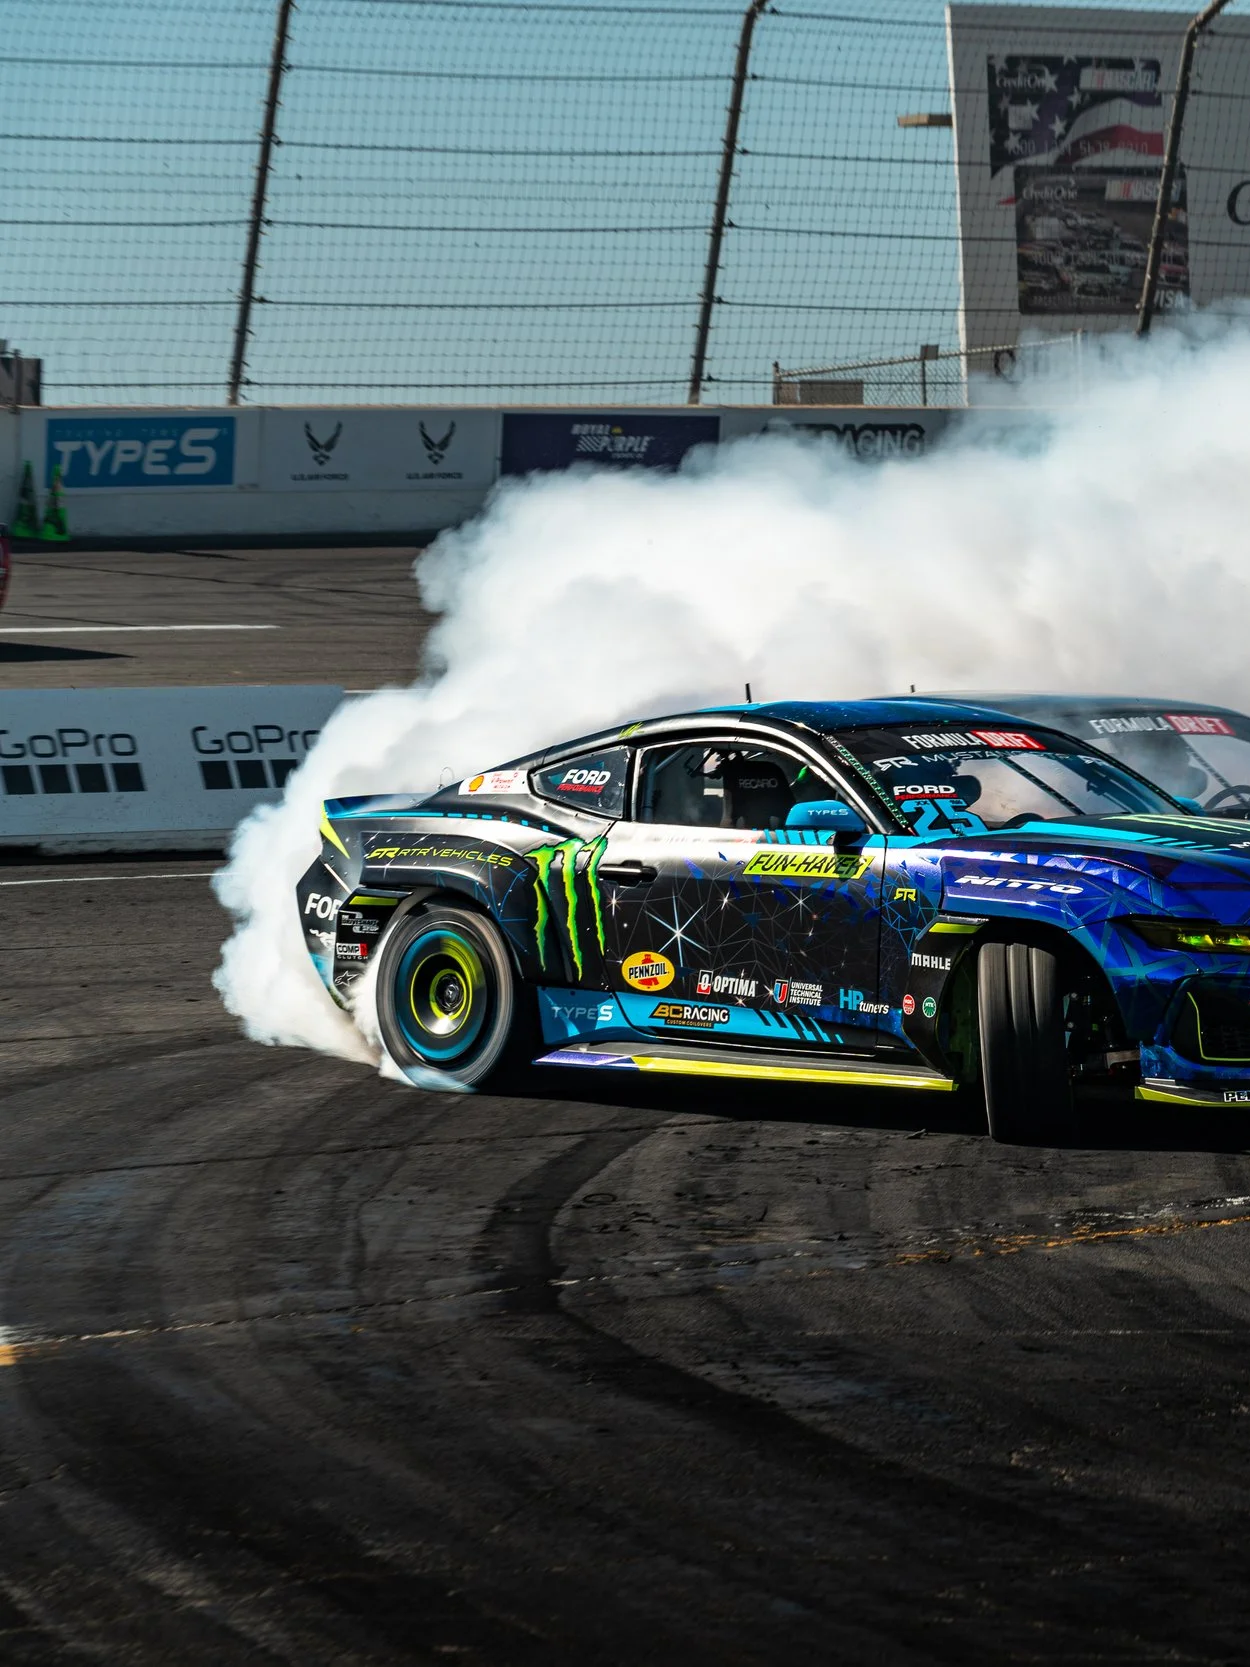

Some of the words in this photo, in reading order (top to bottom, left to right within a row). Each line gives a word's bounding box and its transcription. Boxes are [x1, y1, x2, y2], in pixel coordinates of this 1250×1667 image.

[1088, 716, 1174, 734] FORMULA
[1167, 715, 1230, 734] DRIFT
[0, 728, 137, 759] GoPro
[902, 732, 988, 750] FORMULA
[976, 731, 1041, 749] DRIFT
[561, 769, 611, 785] FORD
[739, 778, 779, 789] RECARO
[893, 785, 956, 796] FORD
[900, 799, 989, 838] 25
[432, 848, 513, 867] VEHICLES
[748, 853, 868, 876] FUN-HAVER
[954, 875, 1084, 894] NITTO
[911, 952, 951, 971] MAHLE
[628, 963, 668, 980] PENNZOIL
[713, 975, 756, 997] OPTIMA
[790, 990, 822, 999] TECHNICAL
[791, 981, 823, 992] UNIVERSAL
[789, 996, 821, 1006] INSTITUTE
[839, 988, 865, 1011] HP
[859, 1001, 890, 1015] tuners
